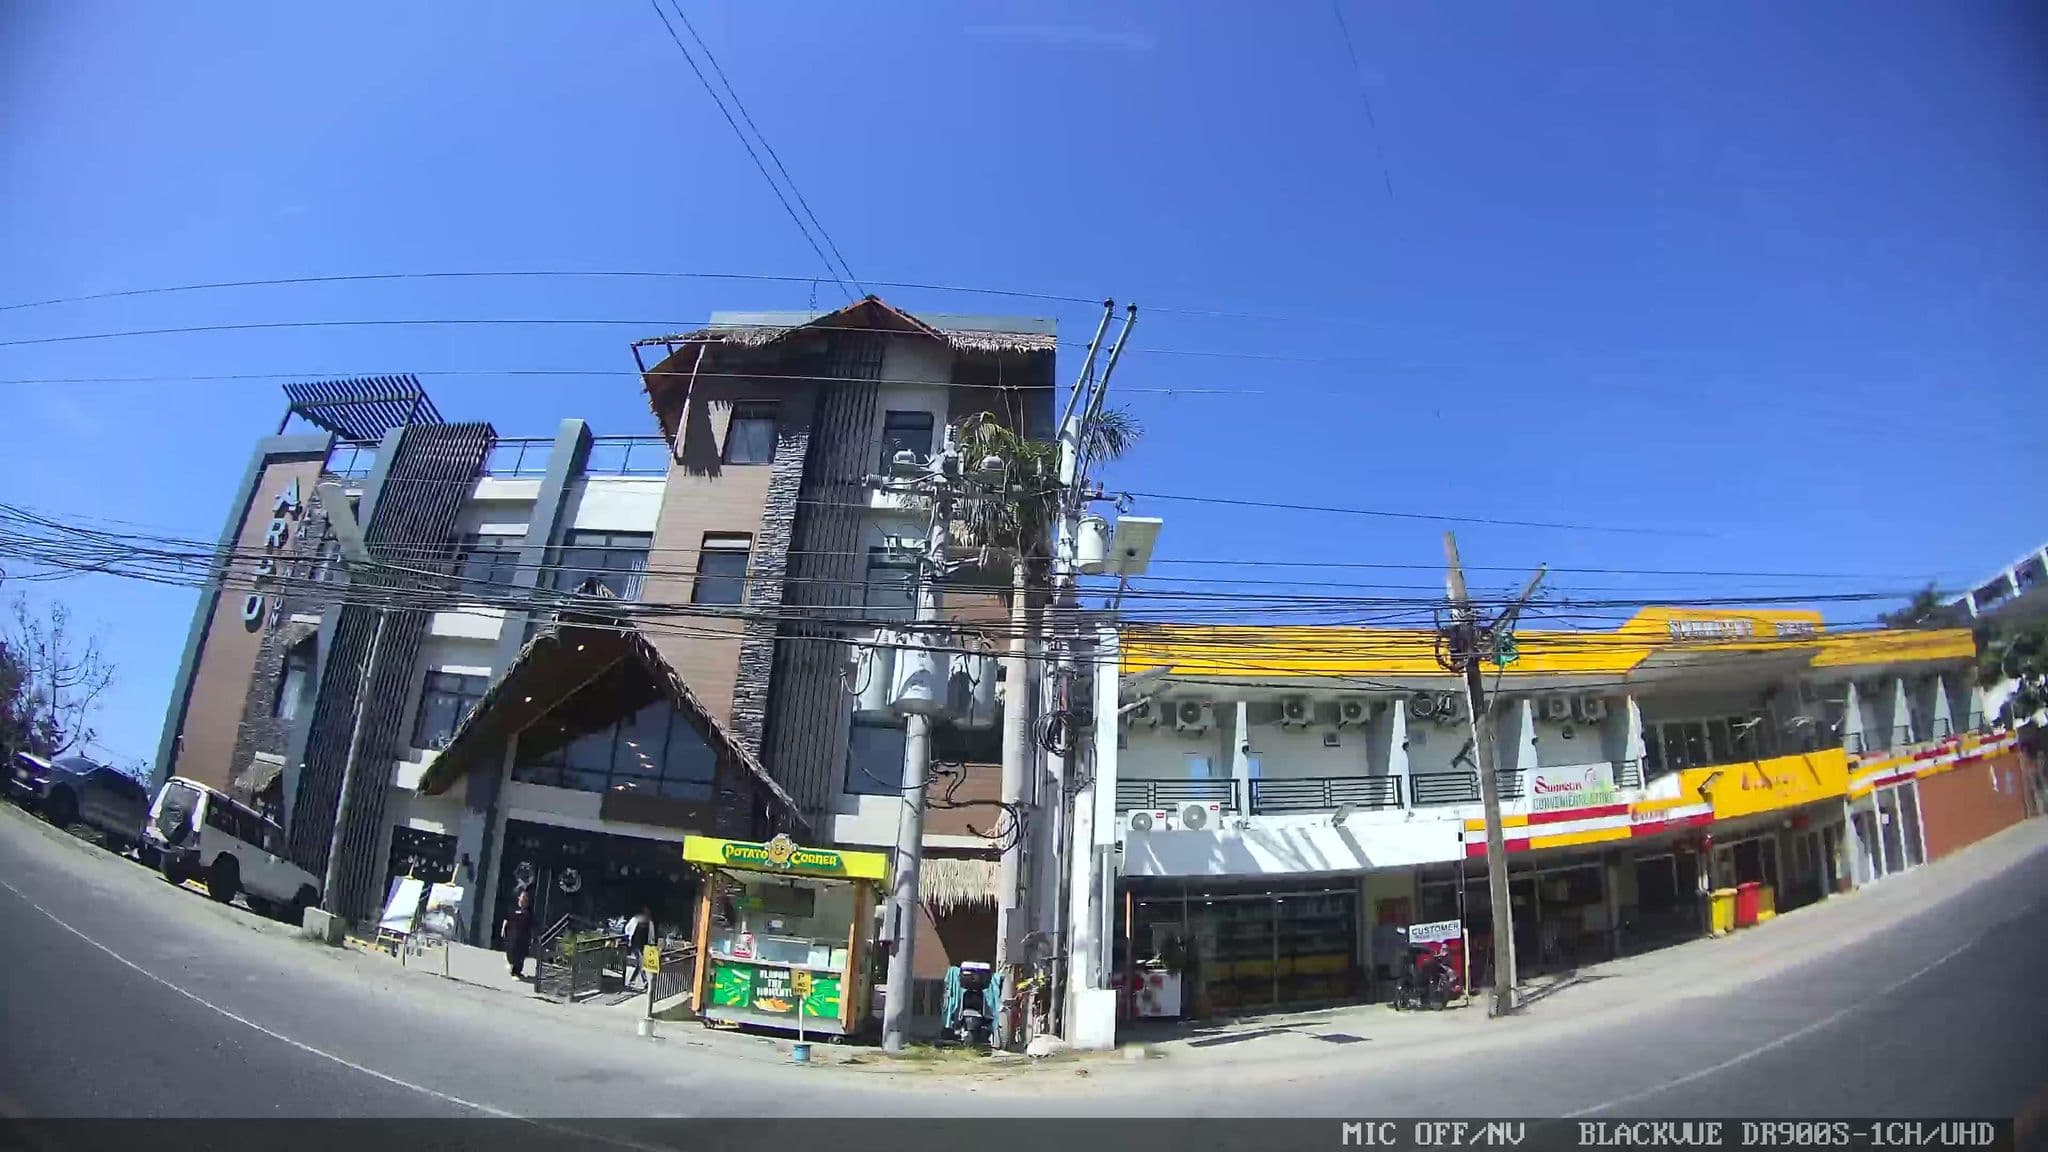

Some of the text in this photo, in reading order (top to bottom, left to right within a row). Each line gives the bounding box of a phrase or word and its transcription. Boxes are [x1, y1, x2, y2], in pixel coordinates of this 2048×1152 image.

[725, 844, 837, 866] POTATO CORNER
[1411, 922, 1459, 936] CUSTOMER
